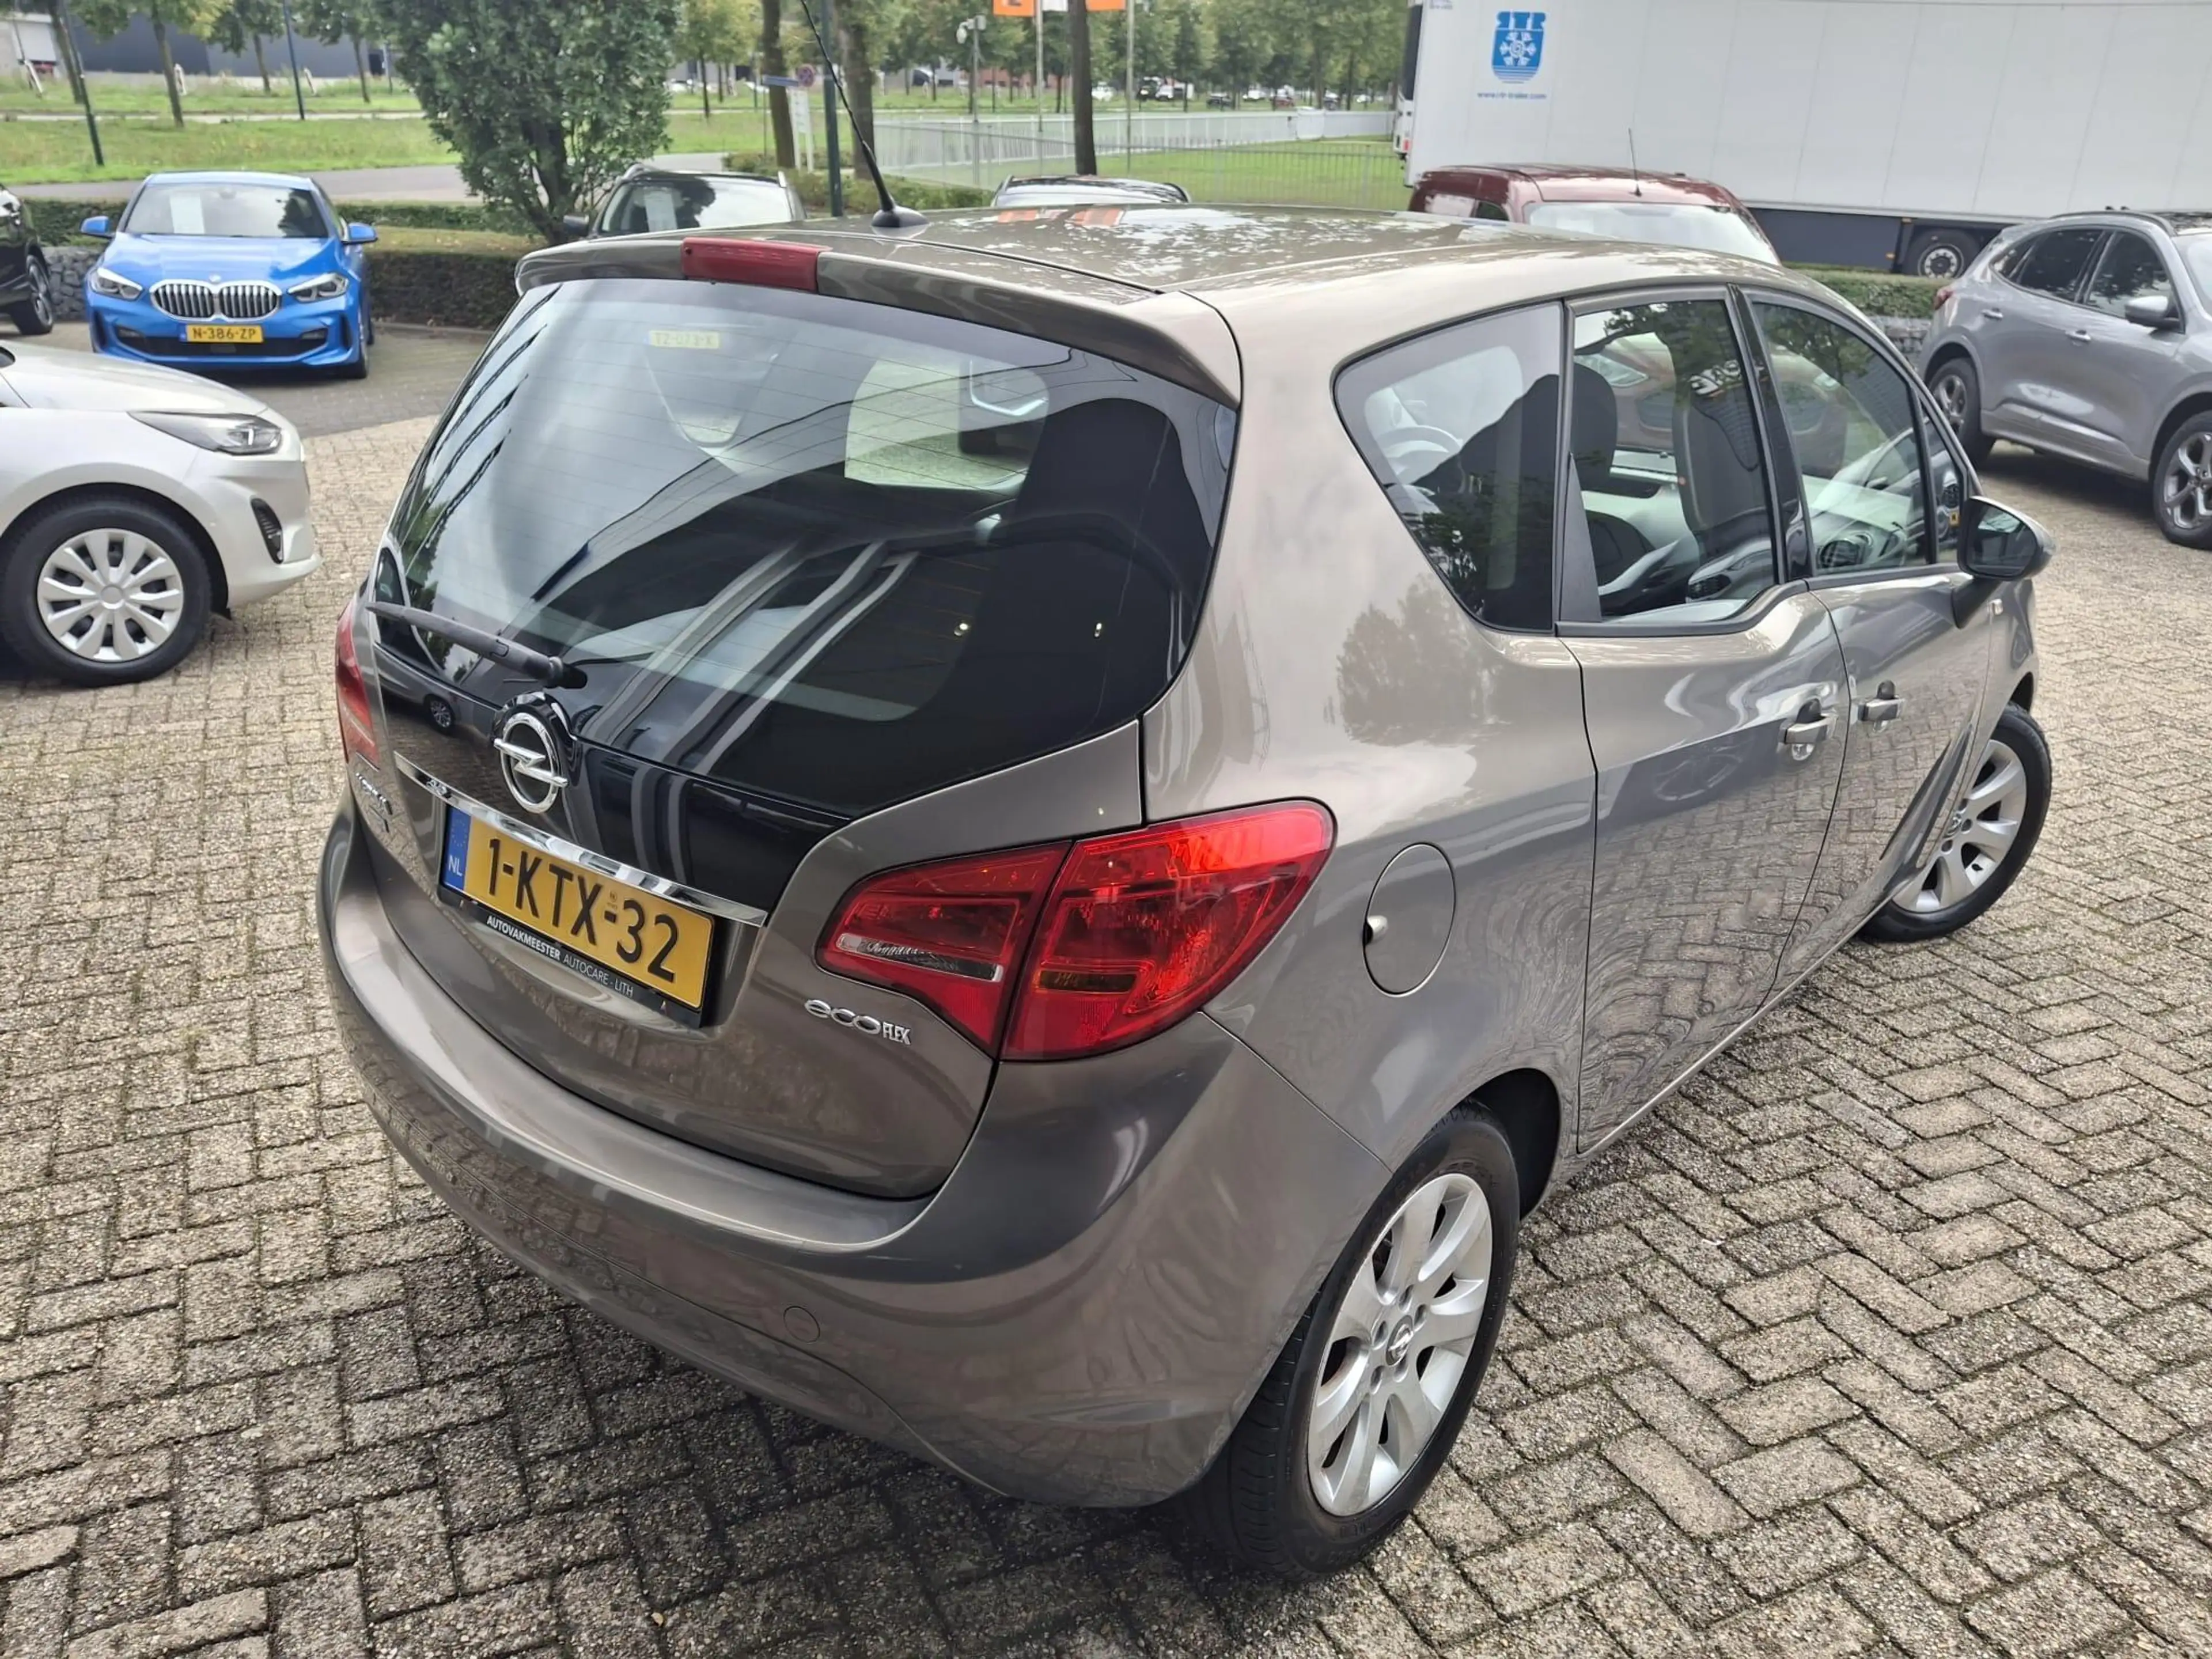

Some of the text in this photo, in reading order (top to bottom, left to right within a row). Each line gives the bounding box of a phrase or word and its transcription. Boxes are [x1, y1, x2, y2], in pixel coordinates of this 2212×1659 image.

[192, 327, 256, 339] N-386-ZP
[448, 838, 679, 983] NL 1-KTX-32
[486, 915, 561, 961] AUTOVAKMEESTER
[563, 954, 609, 986] AUTOCARE
[614, 979, 634, 998] LITH
